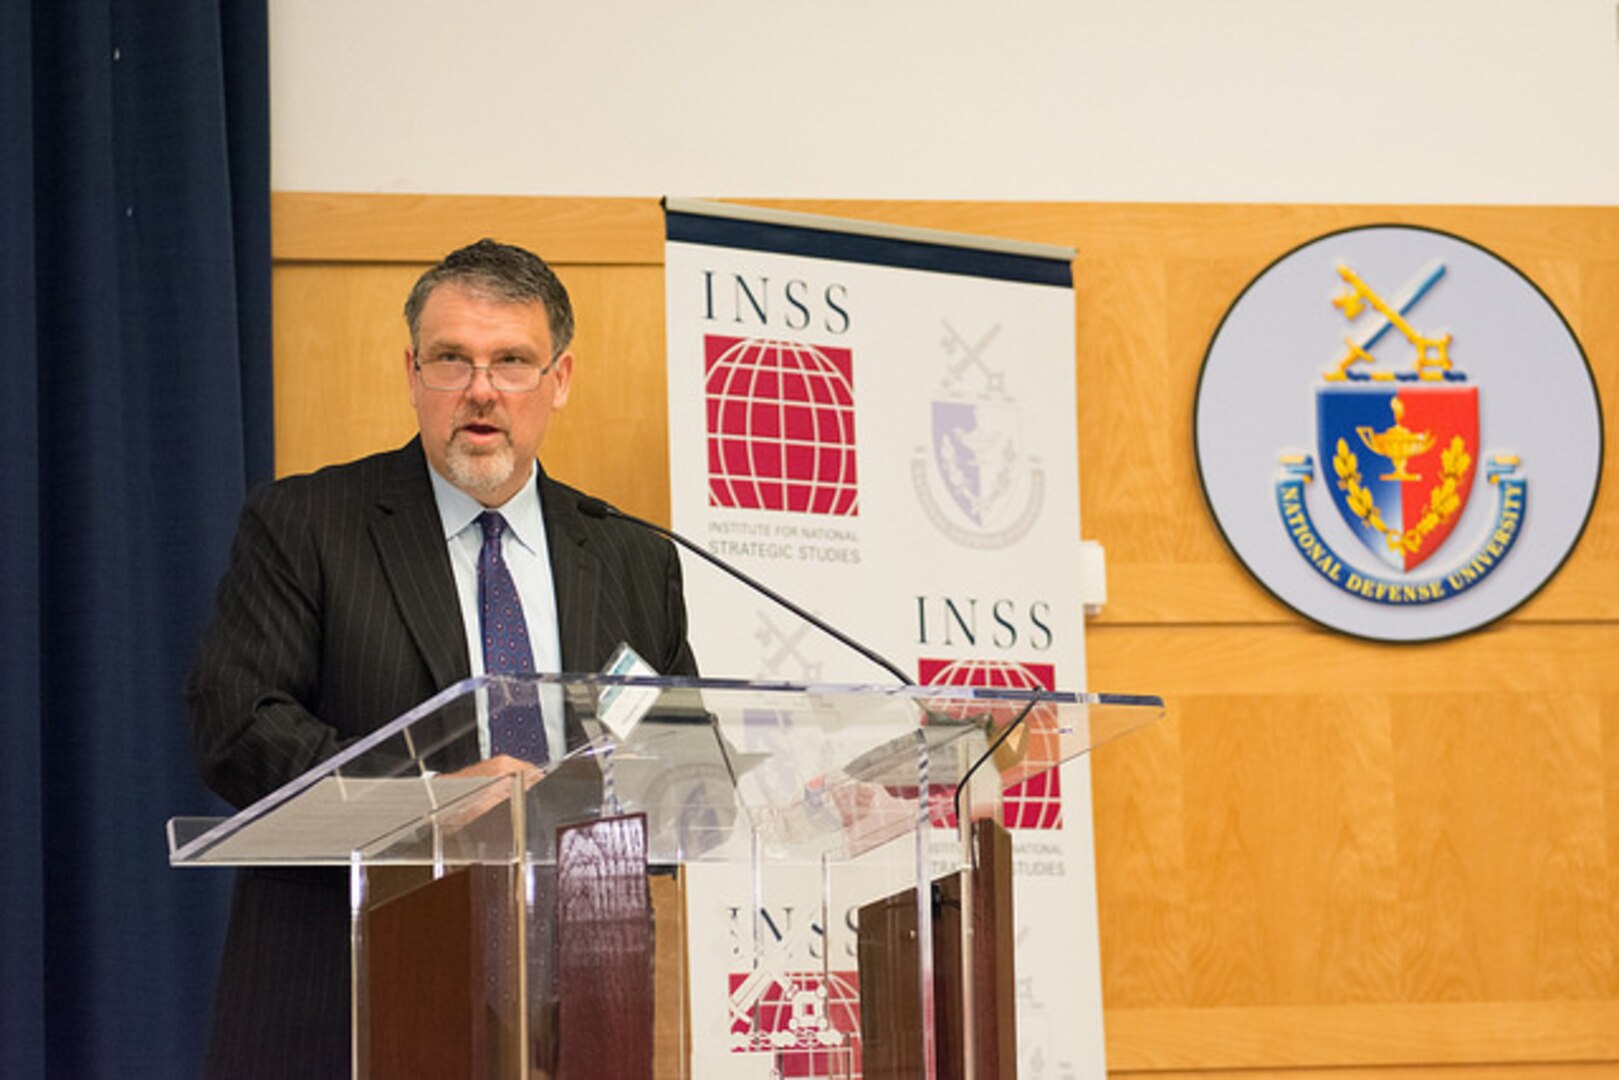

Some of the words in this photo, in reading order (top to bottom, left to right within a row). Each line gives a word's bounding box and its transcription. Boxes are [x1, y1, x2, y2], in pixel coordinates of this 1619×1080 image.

[702, 270, 851, 334] INSS
[708, 521, 770, 536] INSTITUTE
[775, 525, 797, 537] FOR
[801, 527, 859, 542] NATIONAL
[708, 540, 793, 559] STRATEGIC
[799, 546, 861, 564] STUDIES
[1280, 486, 1341, 582] NATIONAL
[1346, 574, 1445, 602] DEFENSE
[1449, 485, 1523, 591] UNIVERSITY
[915, 596, 1054, 650] INSS
